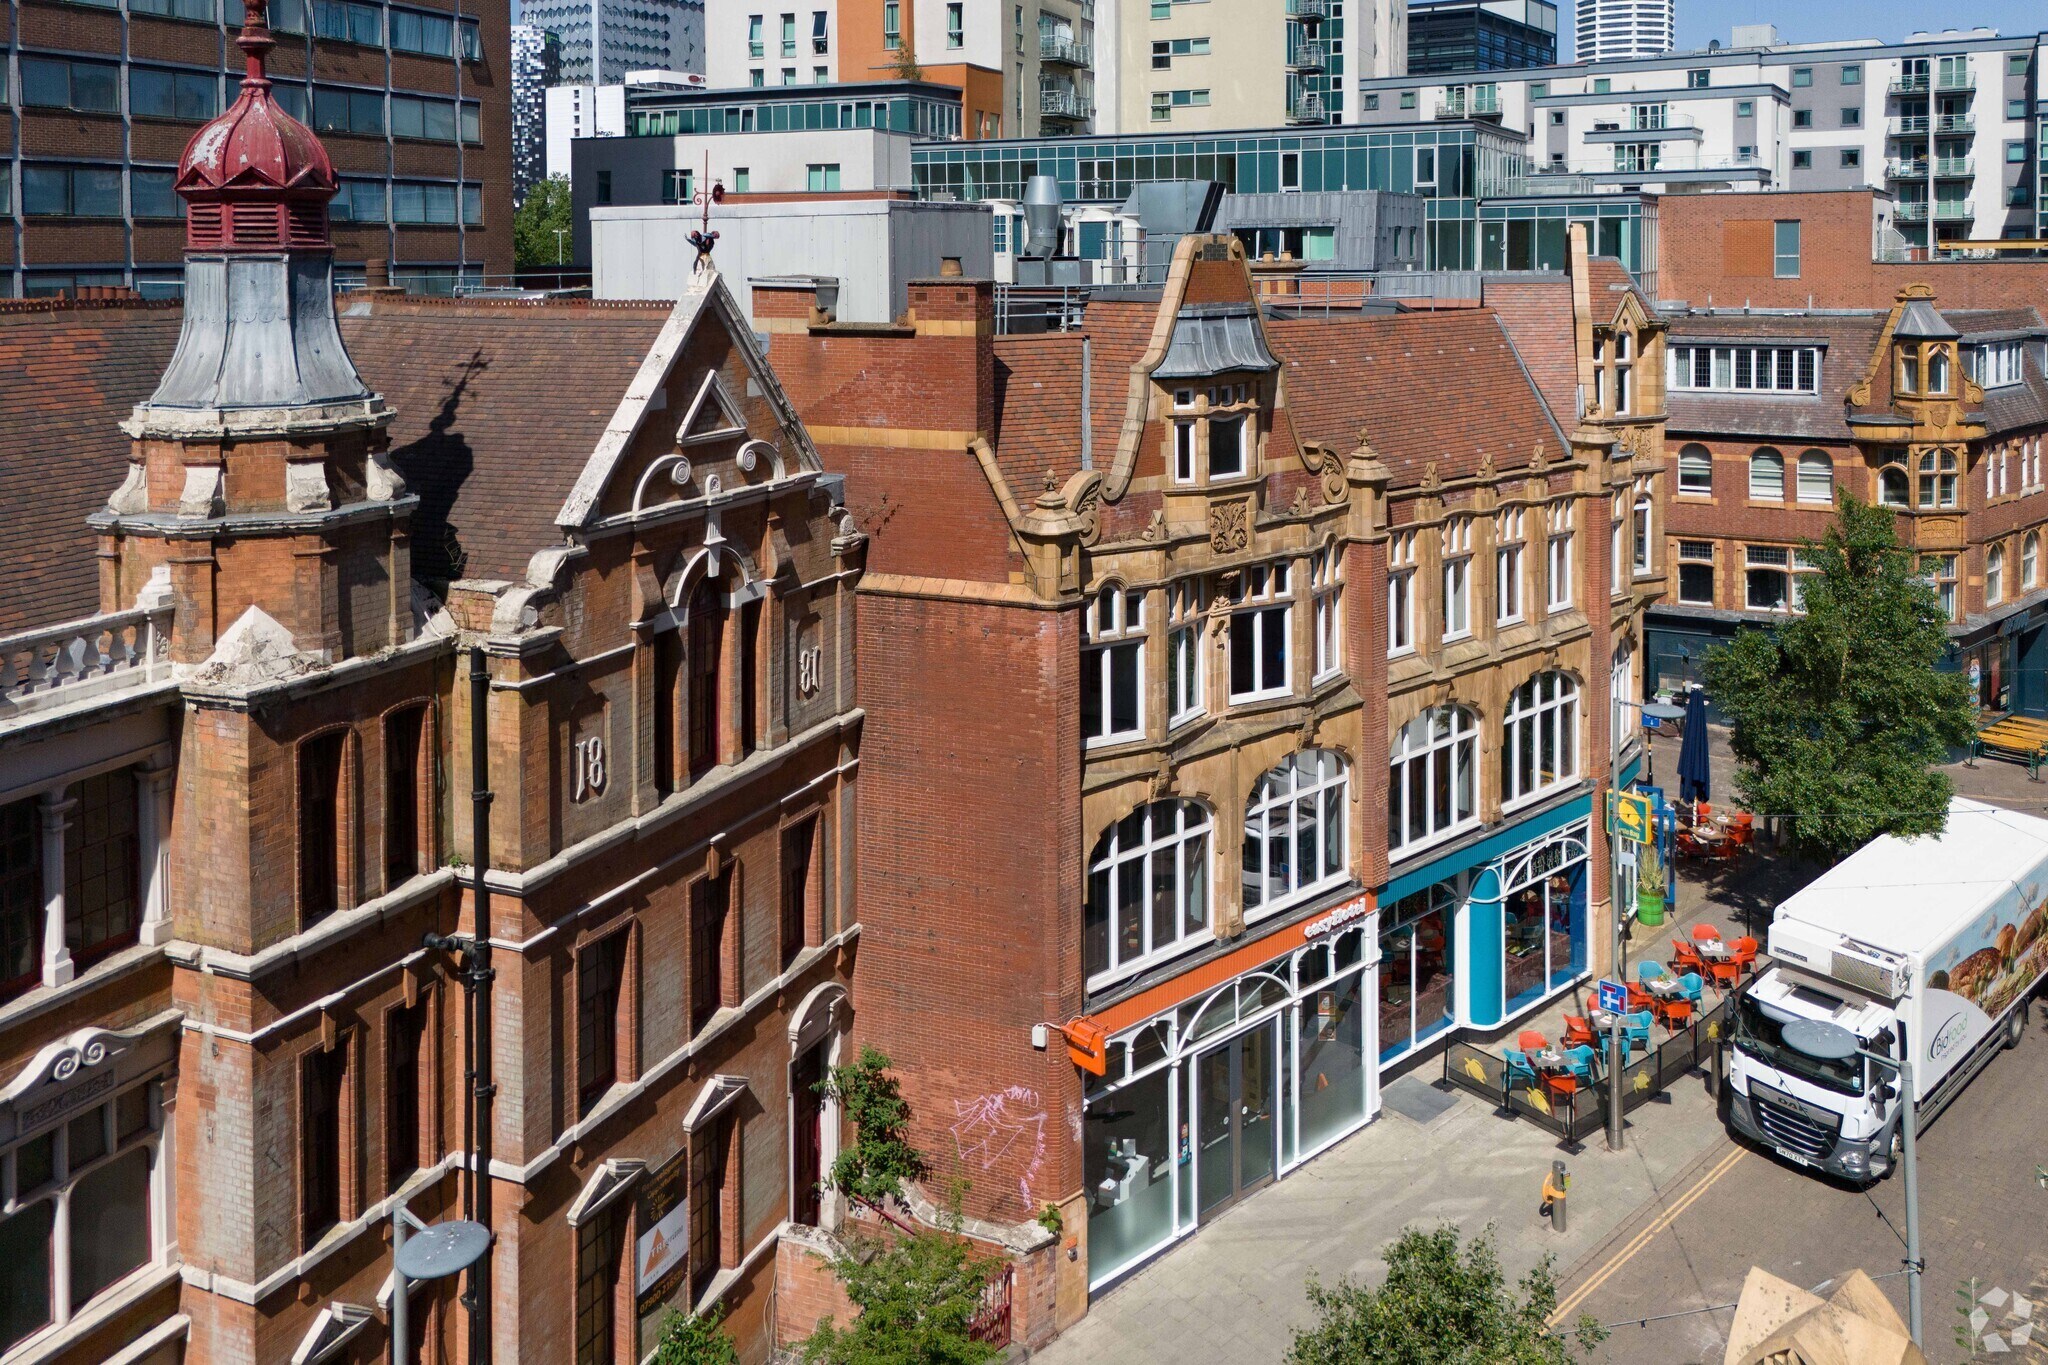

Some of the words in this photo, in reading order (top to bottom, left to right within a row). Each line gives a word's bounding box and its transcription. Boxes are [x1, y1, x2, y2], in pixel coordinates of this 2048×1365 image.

[575, 736, 603, 802] 18
[1304, 897, 1366, 938] easyHotel
[1936, 1012, 1968, 1055] Bidfood
[1778, 1096, 1808, 1112] DAF
